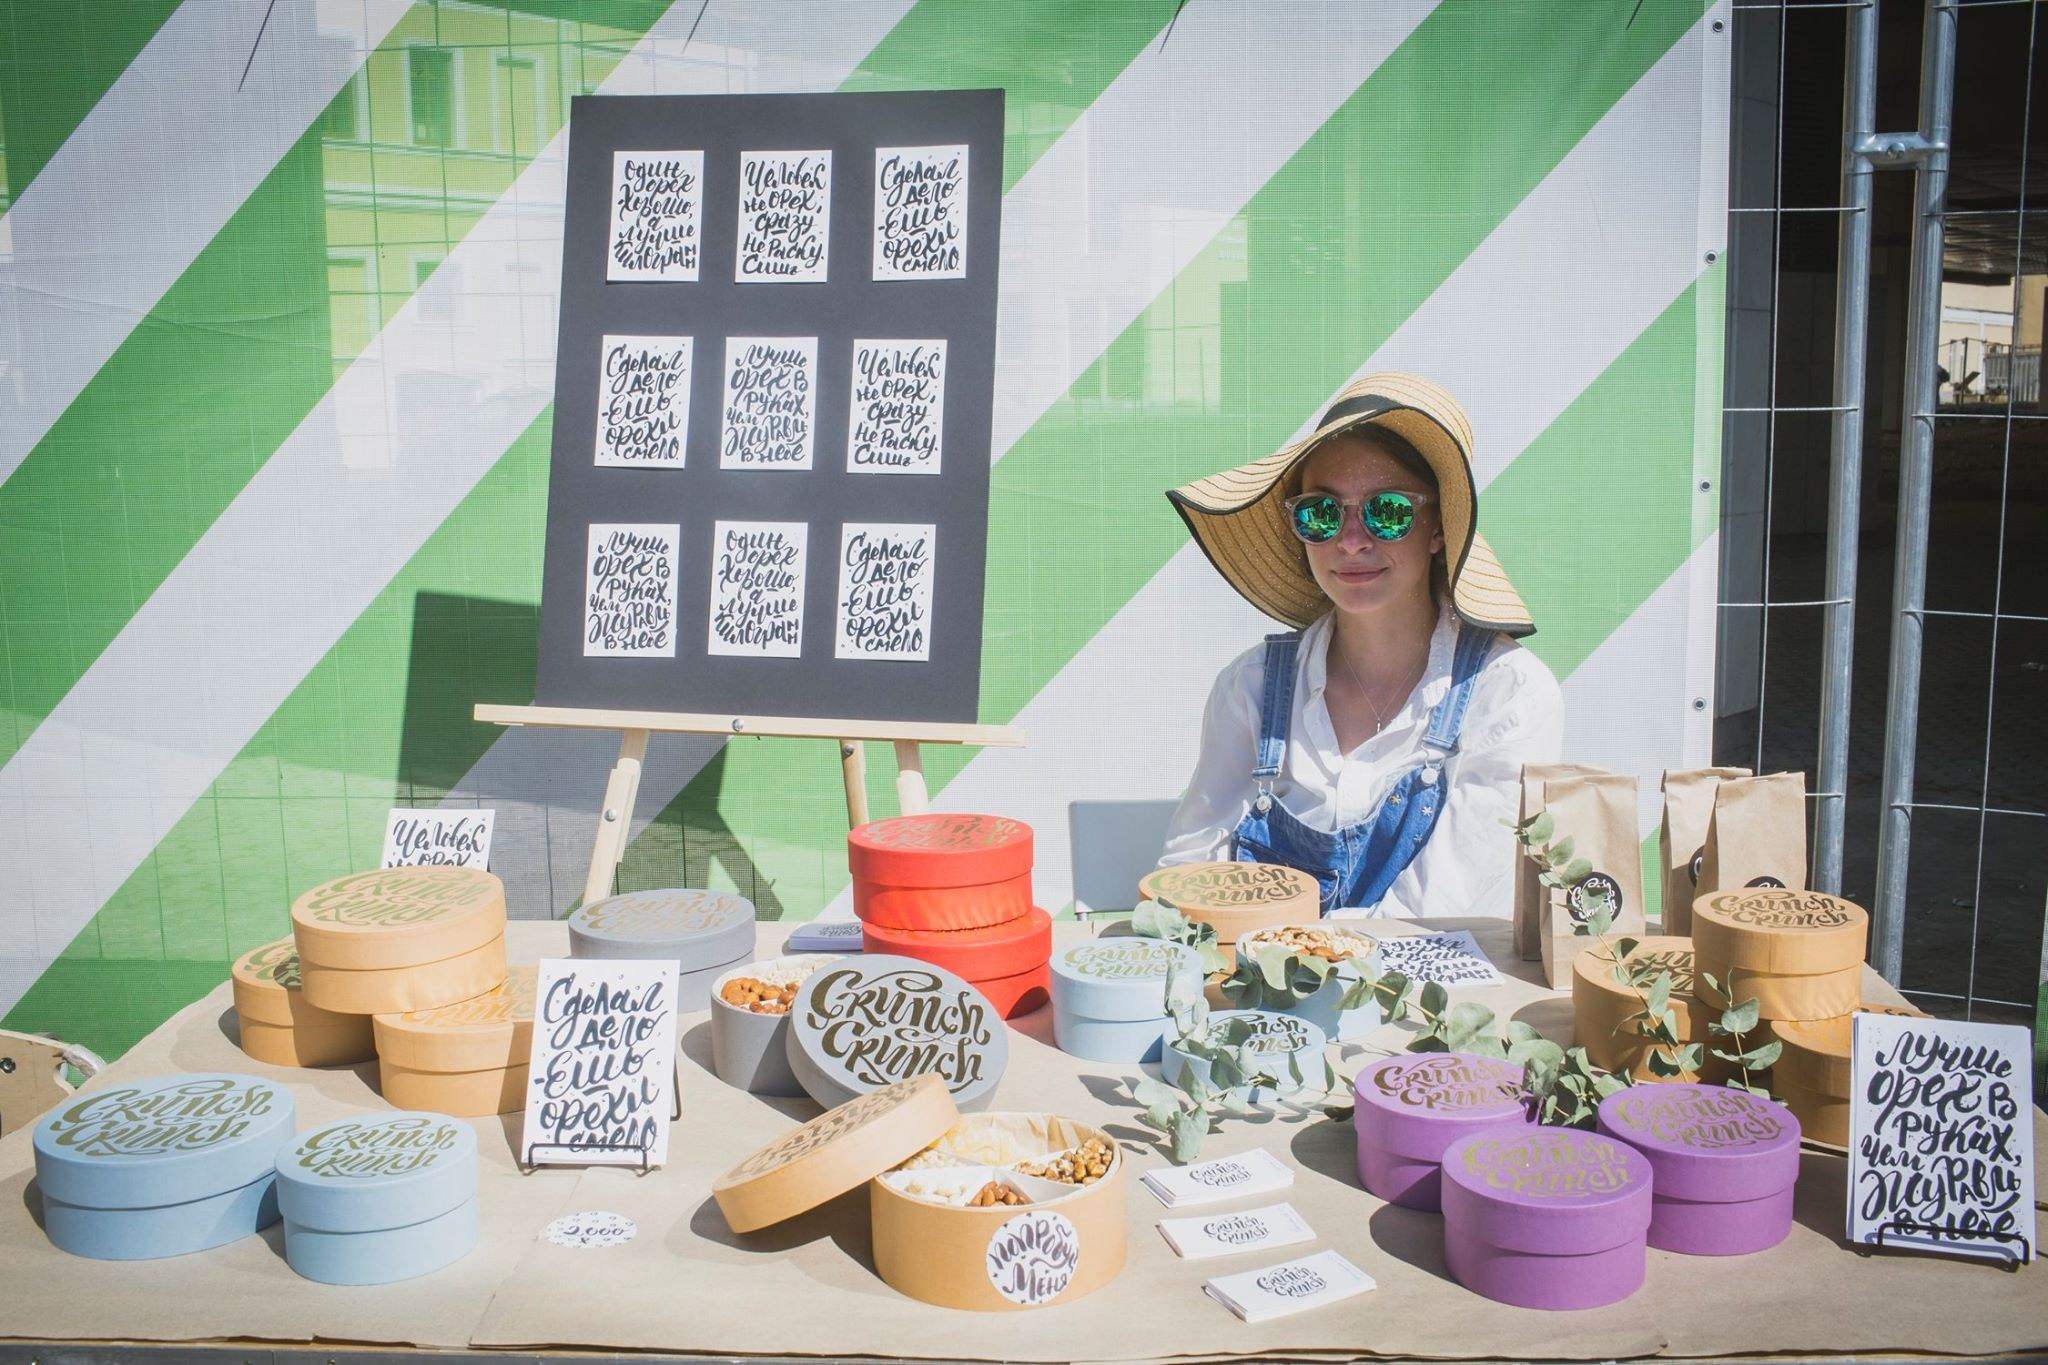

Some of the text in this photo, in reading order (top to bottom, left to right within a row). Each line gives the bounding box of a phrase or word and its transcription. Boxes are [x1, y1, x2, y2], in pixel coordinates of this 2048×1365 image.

[646, 174, 695, 206] орех
[745, 157, 826, 197] Человек
[881, 155, 959, 207] Сделал
[902, 177, 962, 209] дело
[619, 225, 695, 254] лучше
[648, 216, 662, 231] а
[883, 221, 959, 269] орехи
[902, 246, 959, 272] смело
[606, 344, 683, 394] Сделал
[626, 369, 686, 397] дело
[858, 346, 940, 385] Человек
[606, 411, 680, 456] орехи
[623, 436, 679, 460] смело
[748, 547, 798, 579] орех
[846, 532, 926, 584] Сделал
[867, 558, 929, 587] дело
[720, 598, 798, 628] лучше
[750, 589, 765, 605] а
[846, 601, 924, 648] орехи
[864, 628, 922, 652] смело
[393, 817, 486, 858] Человек
[1150, 864, 1299, 894] Crunch
[1171, 880, 1306, 906] Crunch
[1710, 891, 1845, 916] Crunch
[1732, 909, 1853, 928] Crunch
[544, 972, 665, 1050] Сделал
[807, 970, 991, 1046] Crunch
[575, 1010, 668, 1054] дело
[822, 1020, 983, 1093] Crunch
[1374, 1057, 1518, 1096] Crunch
[50, 1080, 273, 1131] Crunch
[540, 1076, 660, 1144] орехи
[1617, 1089, 1767, 1129] Crunch
[55, 1113, 250, 1156] Crunch
[296, 1118, 458, 1156] Crunch
[569, 1115, 657, 1153] смело
[1653, 1115, 1786, 1148] Crunch
[299, 1148, 438, 1178] Crunch
[1463, 1132, 1627, 1176] Crunch
[1487, 1163, 1632, 1197] Crunch
